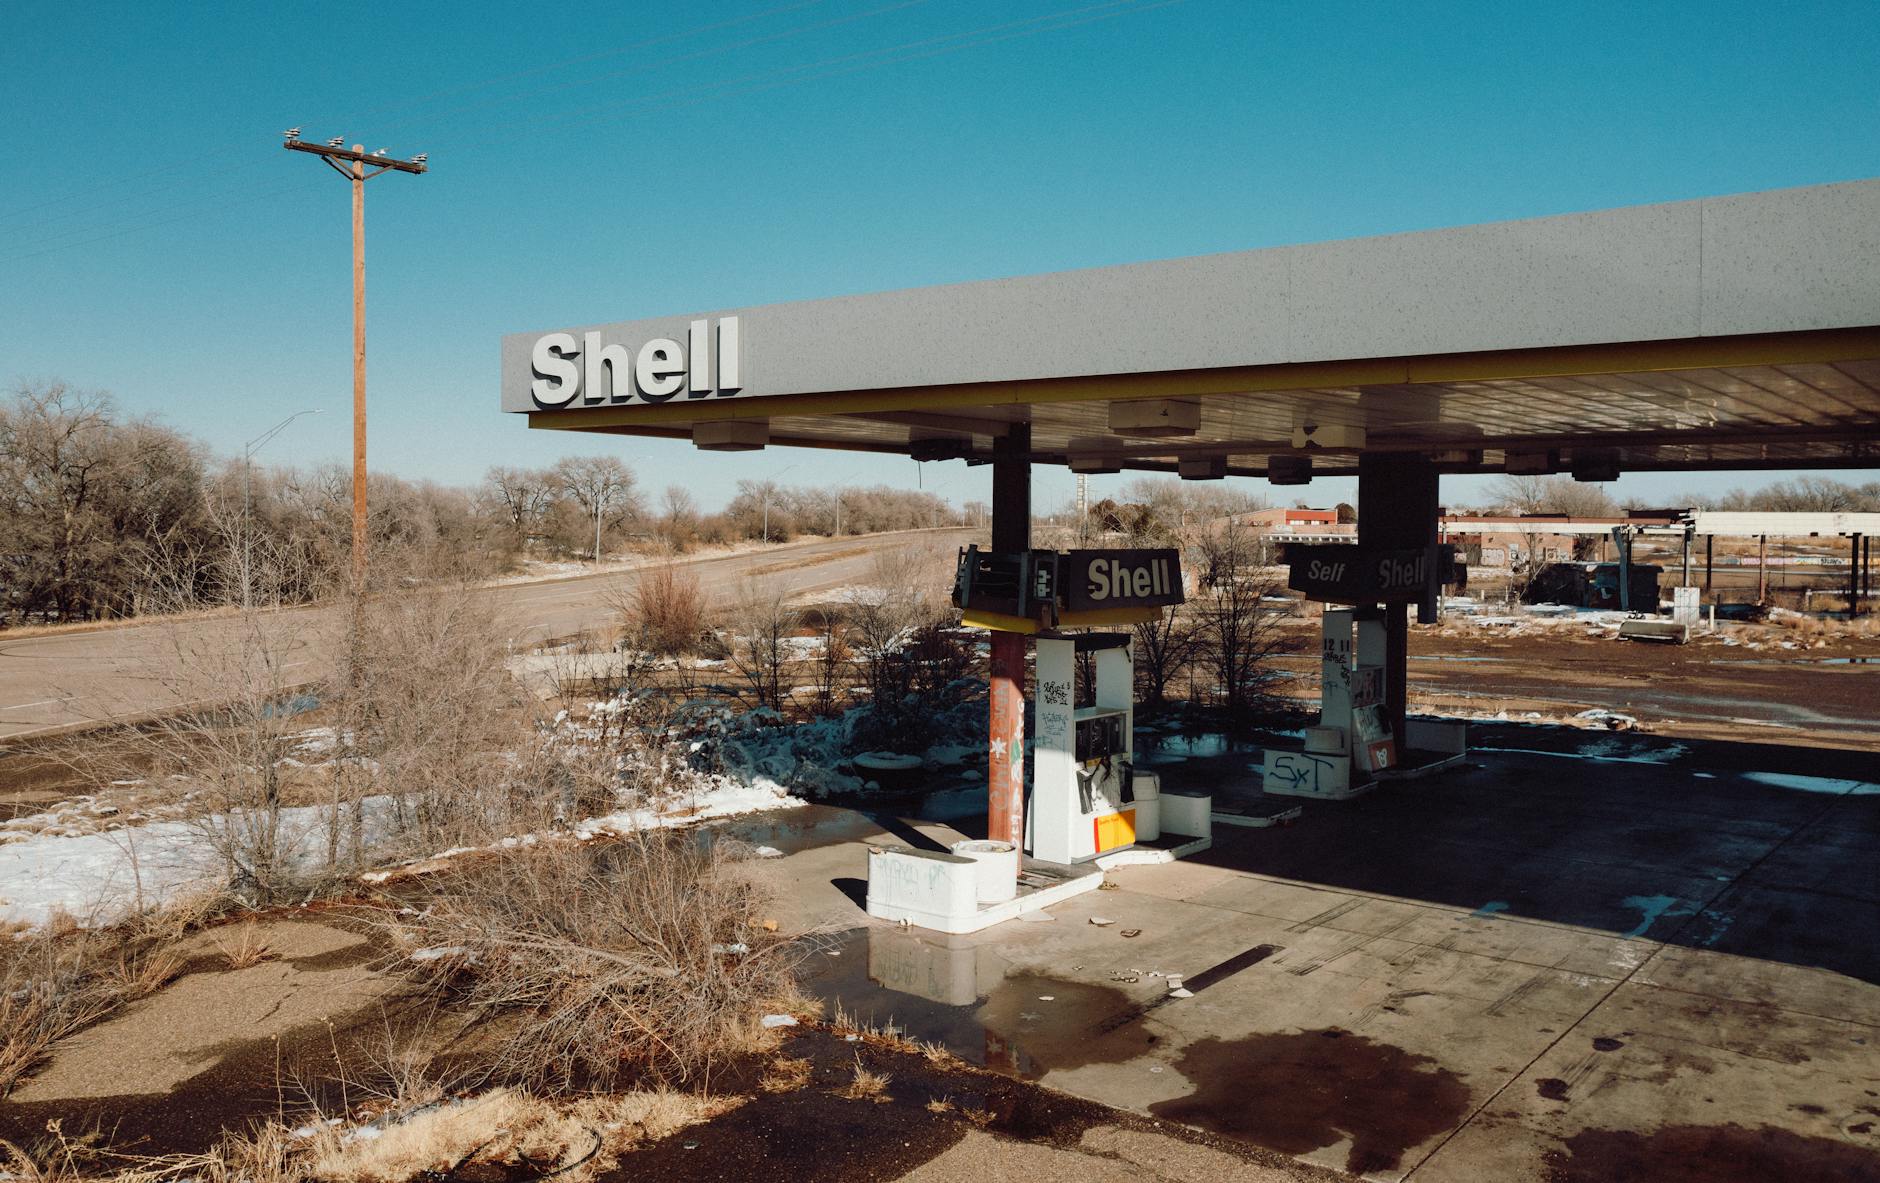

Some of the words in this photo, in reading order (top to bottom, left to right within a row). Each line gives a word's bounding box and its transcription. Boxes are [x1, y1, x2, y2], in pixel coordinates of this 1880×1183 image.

[531, 316, 742, 409] Shell
[1088, 558, 1171, 601] Shell
[1308, 559, 1346, 583] Self
[1378, 556, 1425, 589] Shell
